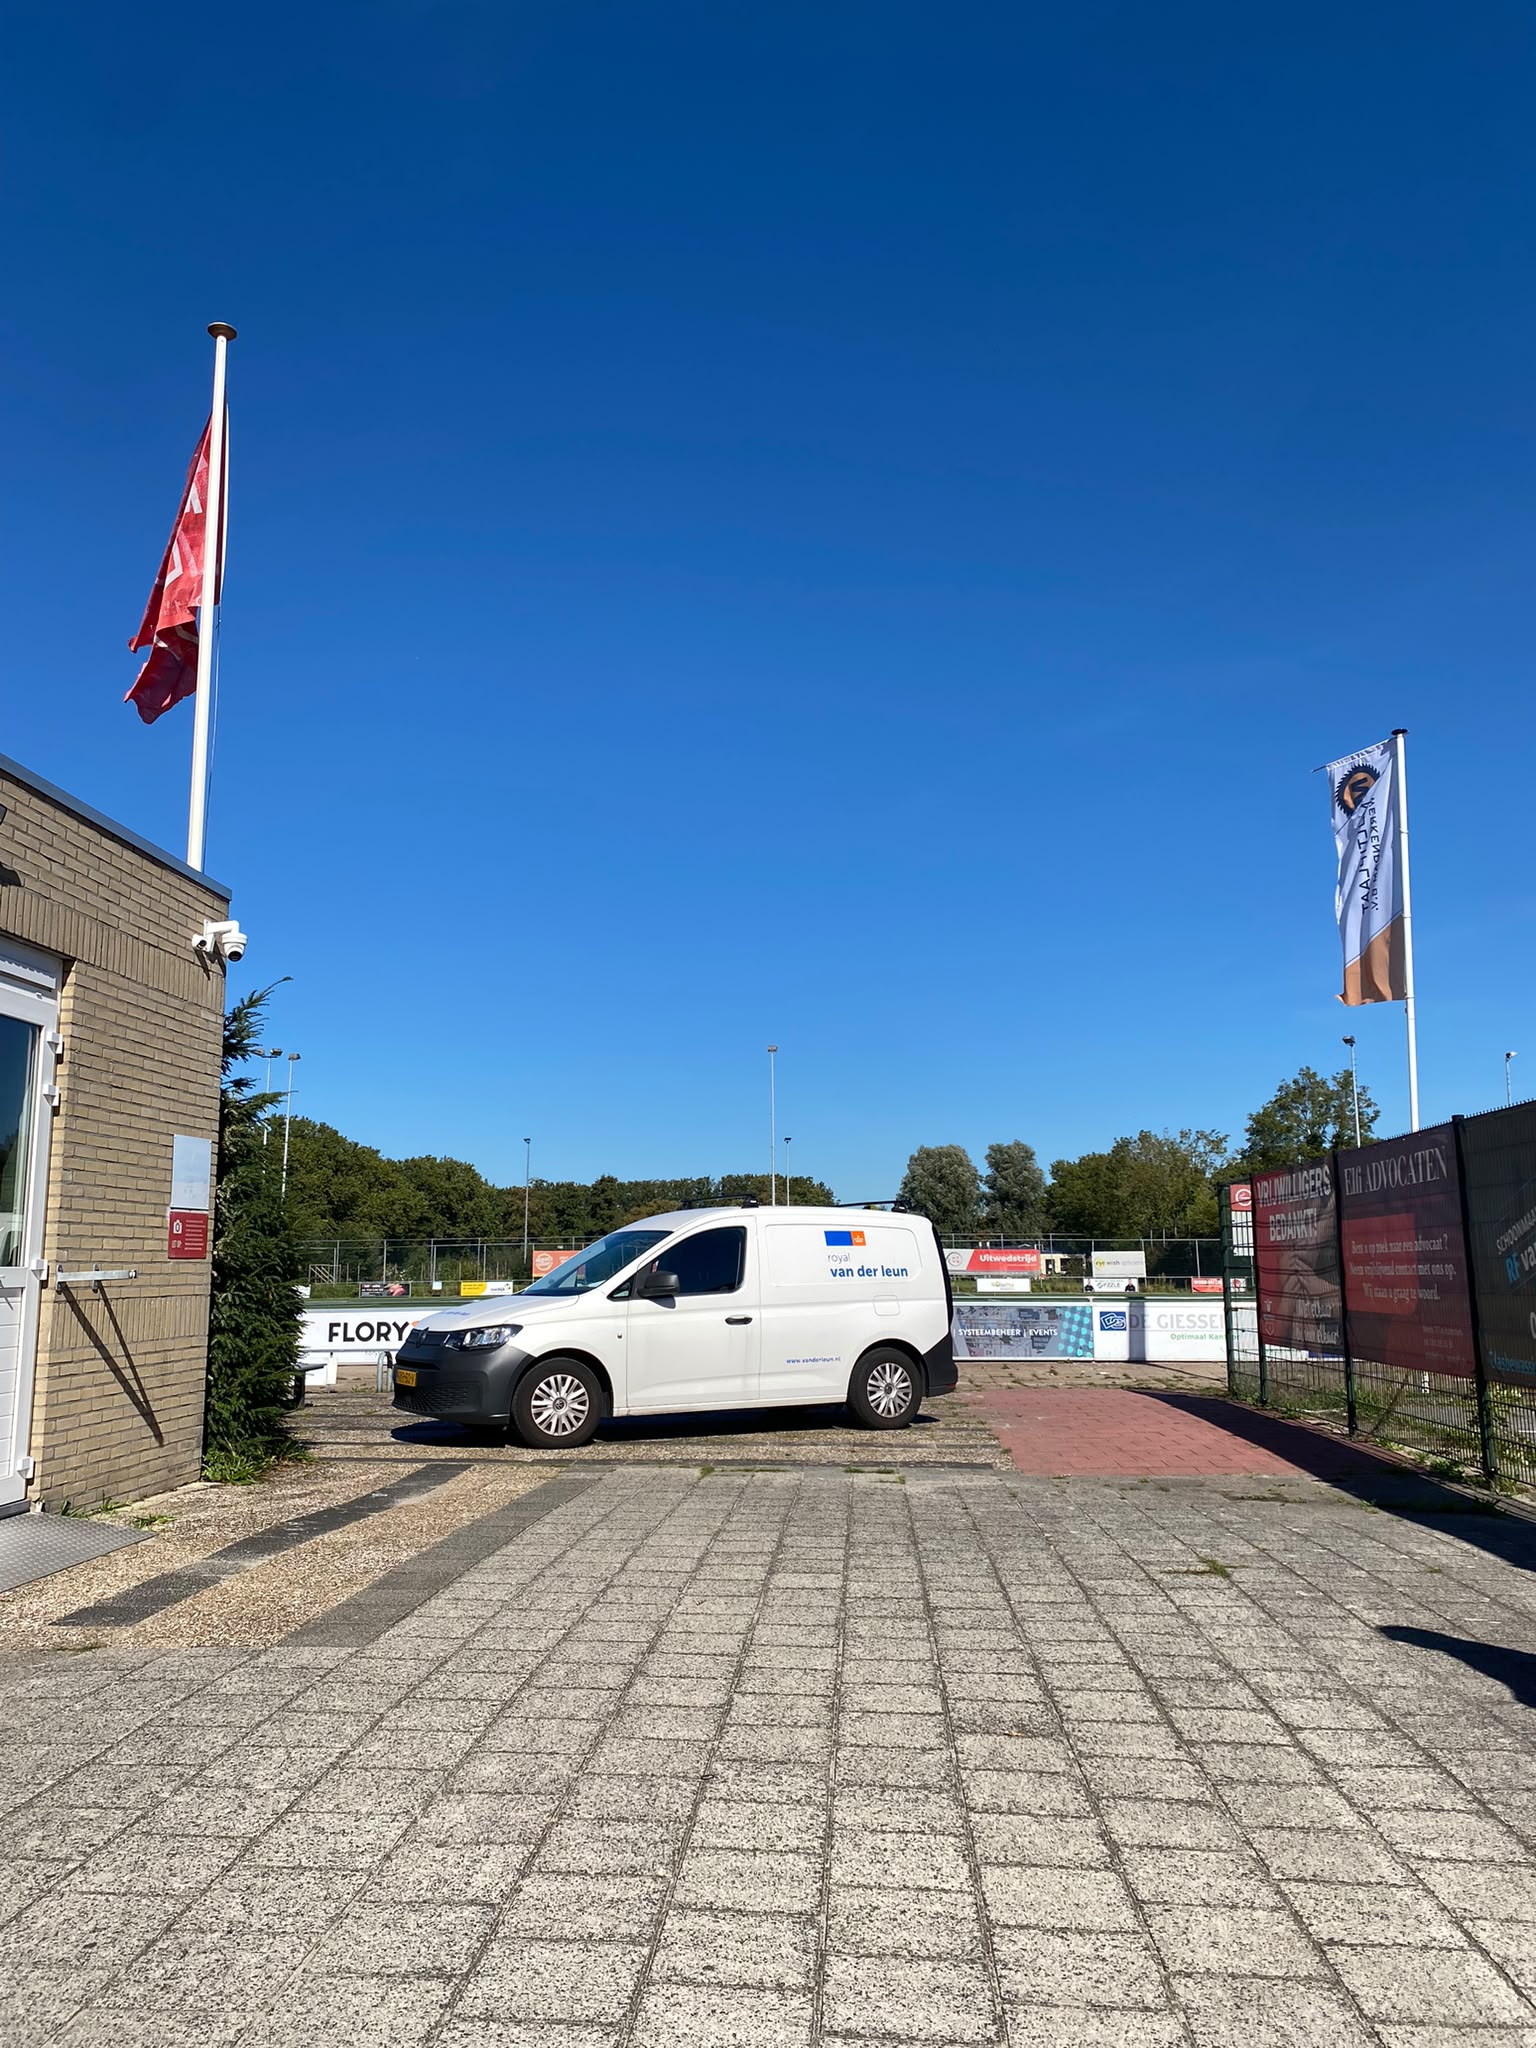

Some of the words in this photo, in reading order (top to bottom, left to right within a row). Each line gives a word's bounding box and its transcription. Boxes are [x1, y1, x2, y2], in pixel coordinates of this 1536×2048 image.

[1365, 1146, 1448, 1193] ADVOCATEN
[1257, 1164, 1332, 1208] VRIJWILLIGERS
[1269, 1208, 1317, 1242] BEDANKT!
[1414, 1234, 1443, 1251] advocaat
[828, 1252, 850, 1264] royal
[979, 1254, 1037, 1264] Uitwedstrijd
[830, 1268, 854, 1277] van
[857, 1265, 878, 1277] der
[881, 1265, 909, 1277] leun
[1431, 1264, 1444, 1275] ons
[1505, 1252, 1520, 1283] RF
[1129, 1314, 1150, 1329] DE
[328, 1321, 410, 1343] FLORY
[958, 1328, 1021, 1336] SYSTEEMBEHEER
[1029, 1328, 1058, 1337] EVENTS
[1170, 1333, 1207, 1341] Optimaal
